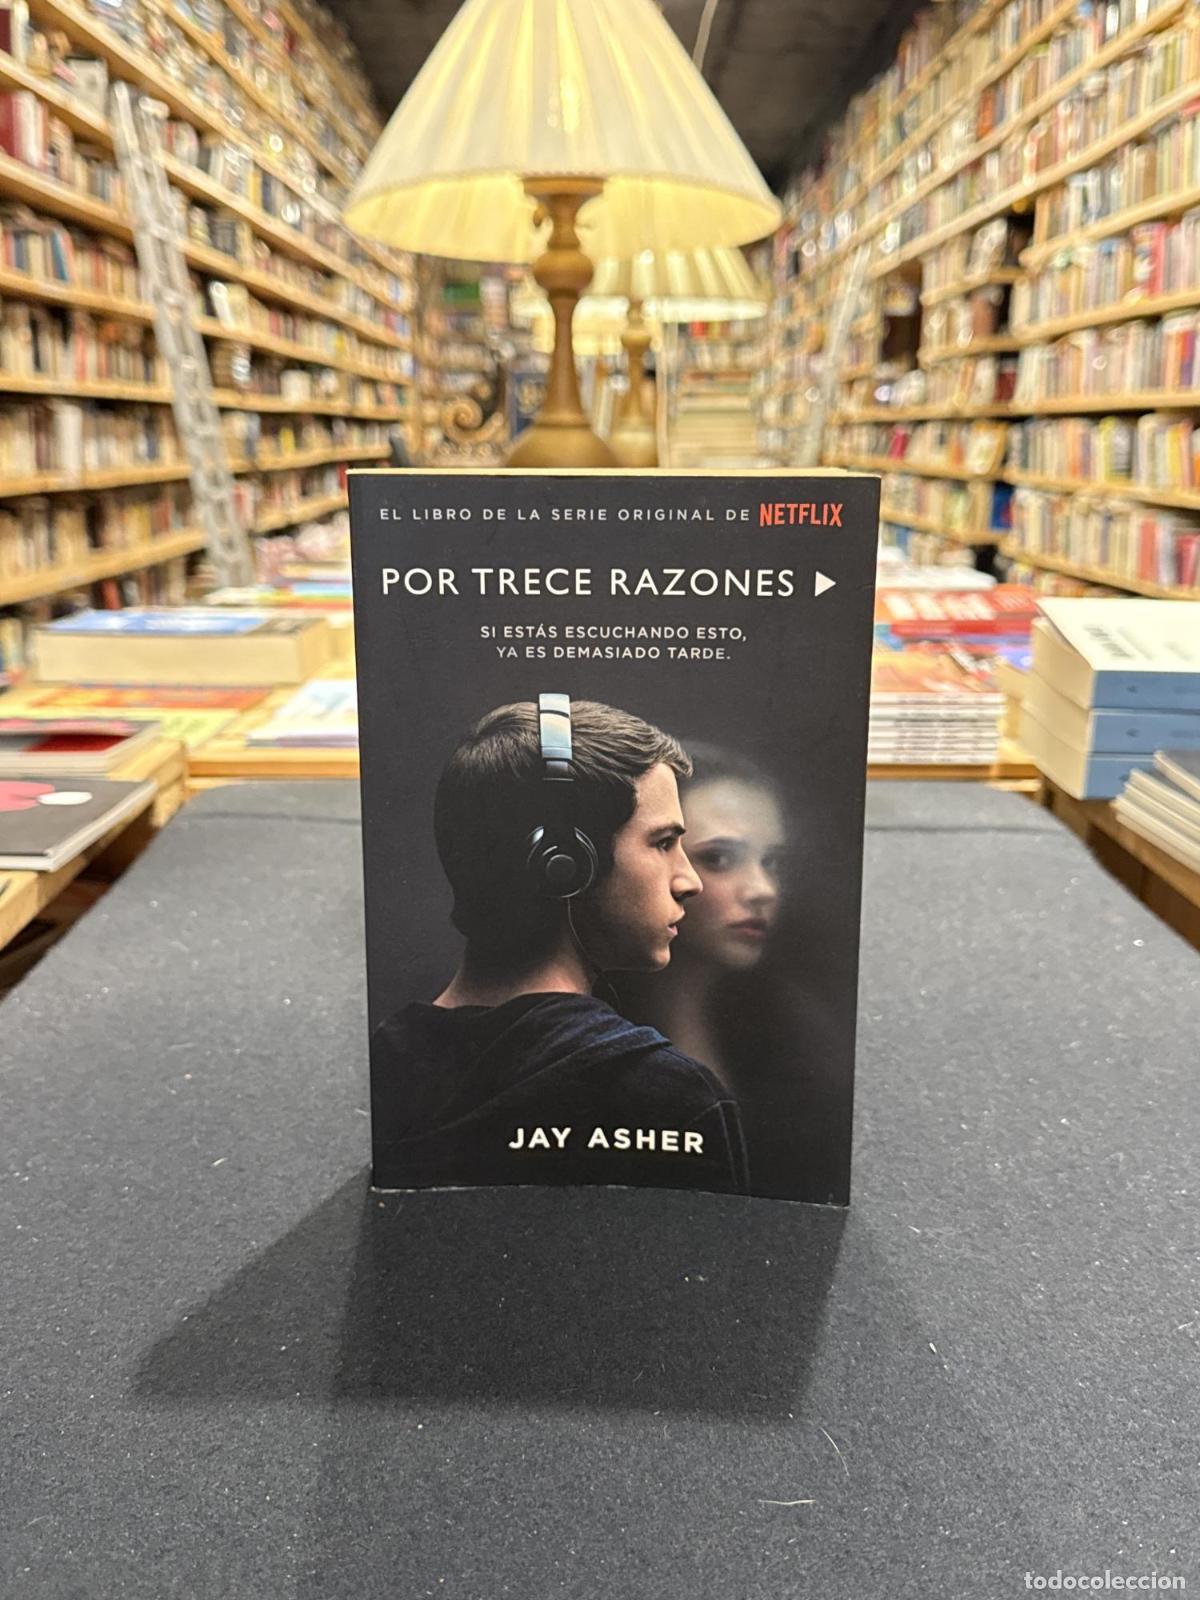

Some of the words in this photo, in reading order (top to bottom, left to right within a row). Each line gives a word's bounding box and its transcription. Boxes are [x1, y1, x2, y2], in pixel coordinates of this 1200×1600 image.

[379, 508, 402, 521] EL
[412, 508, 472, 521] LIBRO
[482, 508, 506, 521] DE
[517, 508, 541, 521] LA
[551, 508, 607, 521] SERIE
[617, 508, 715, 521] ORIGINAL
[725, 508, 750, 521] DE
[759, 502, 844, 528] NETFLIX
[382, 567, 460, 596] POR
[471, 567, 592, 596] TRECE
[610, 568, 794, 597] RAZONES
[480, 625, 496, 639] SI
[503, 623, 558, 640] ESTÁS
[564, 625, 689, 640] ESCUCHANDO
[696, 626, 747, 642] ESTO,
[496, 646, 519, 659] YA
[525, 645, 547, 659] ES
[553, 646, 661, 660] DEMASIADO
[666, 646, 731, 660] TARDE.
[508, 1127, 572, 1149] JAY
[587, 1127, 704, 1154] ASHER
